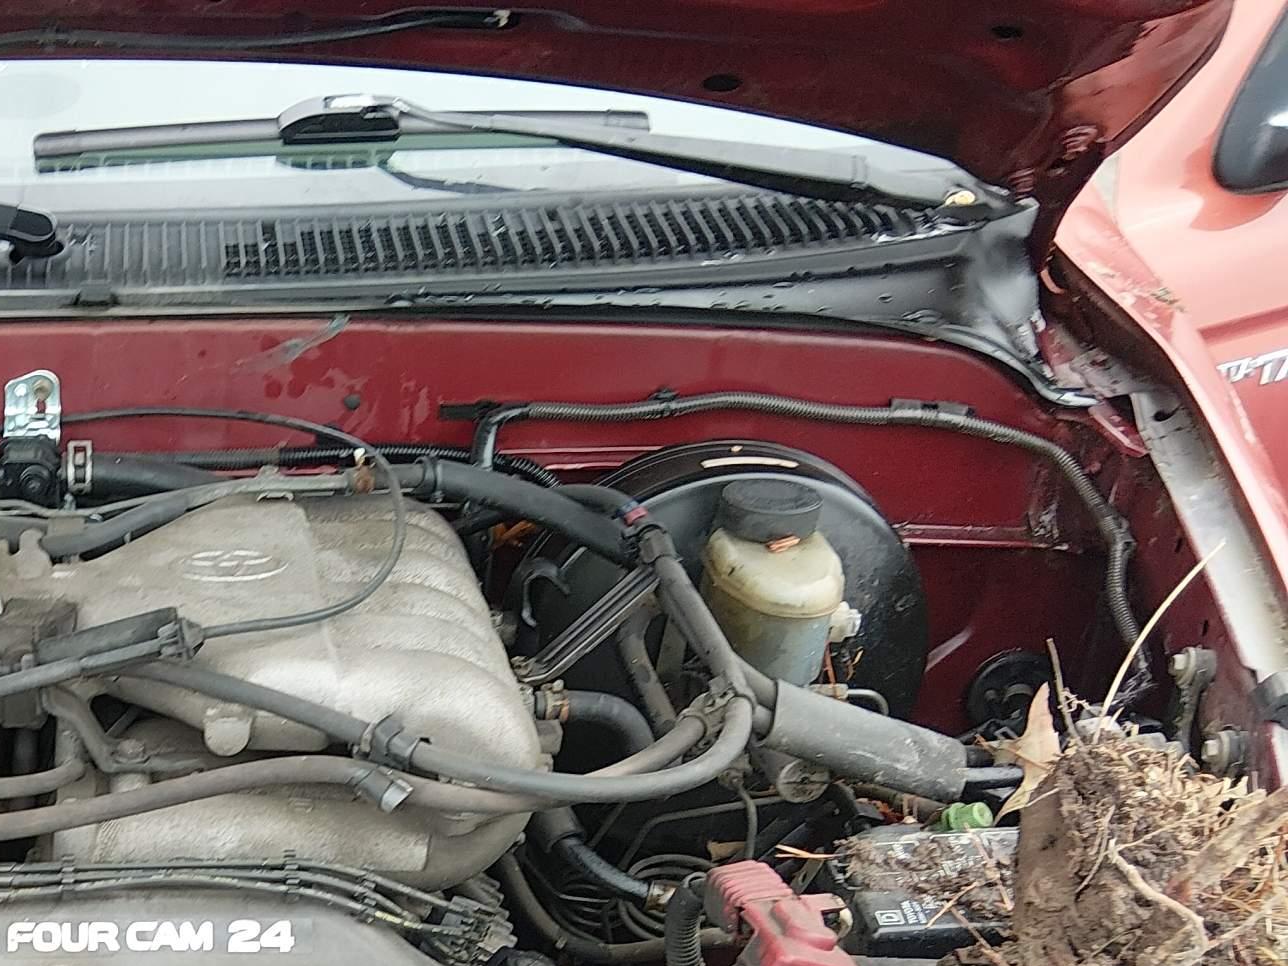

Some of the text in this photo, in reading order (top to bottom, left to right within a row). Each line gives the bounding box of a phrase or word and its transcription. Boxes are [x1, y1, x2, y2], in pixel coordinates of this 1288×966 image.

[7, 920, 120, 953] FOUR
[125, 920, 214, 953] CAM
[227, 919, 295, 953] 24
